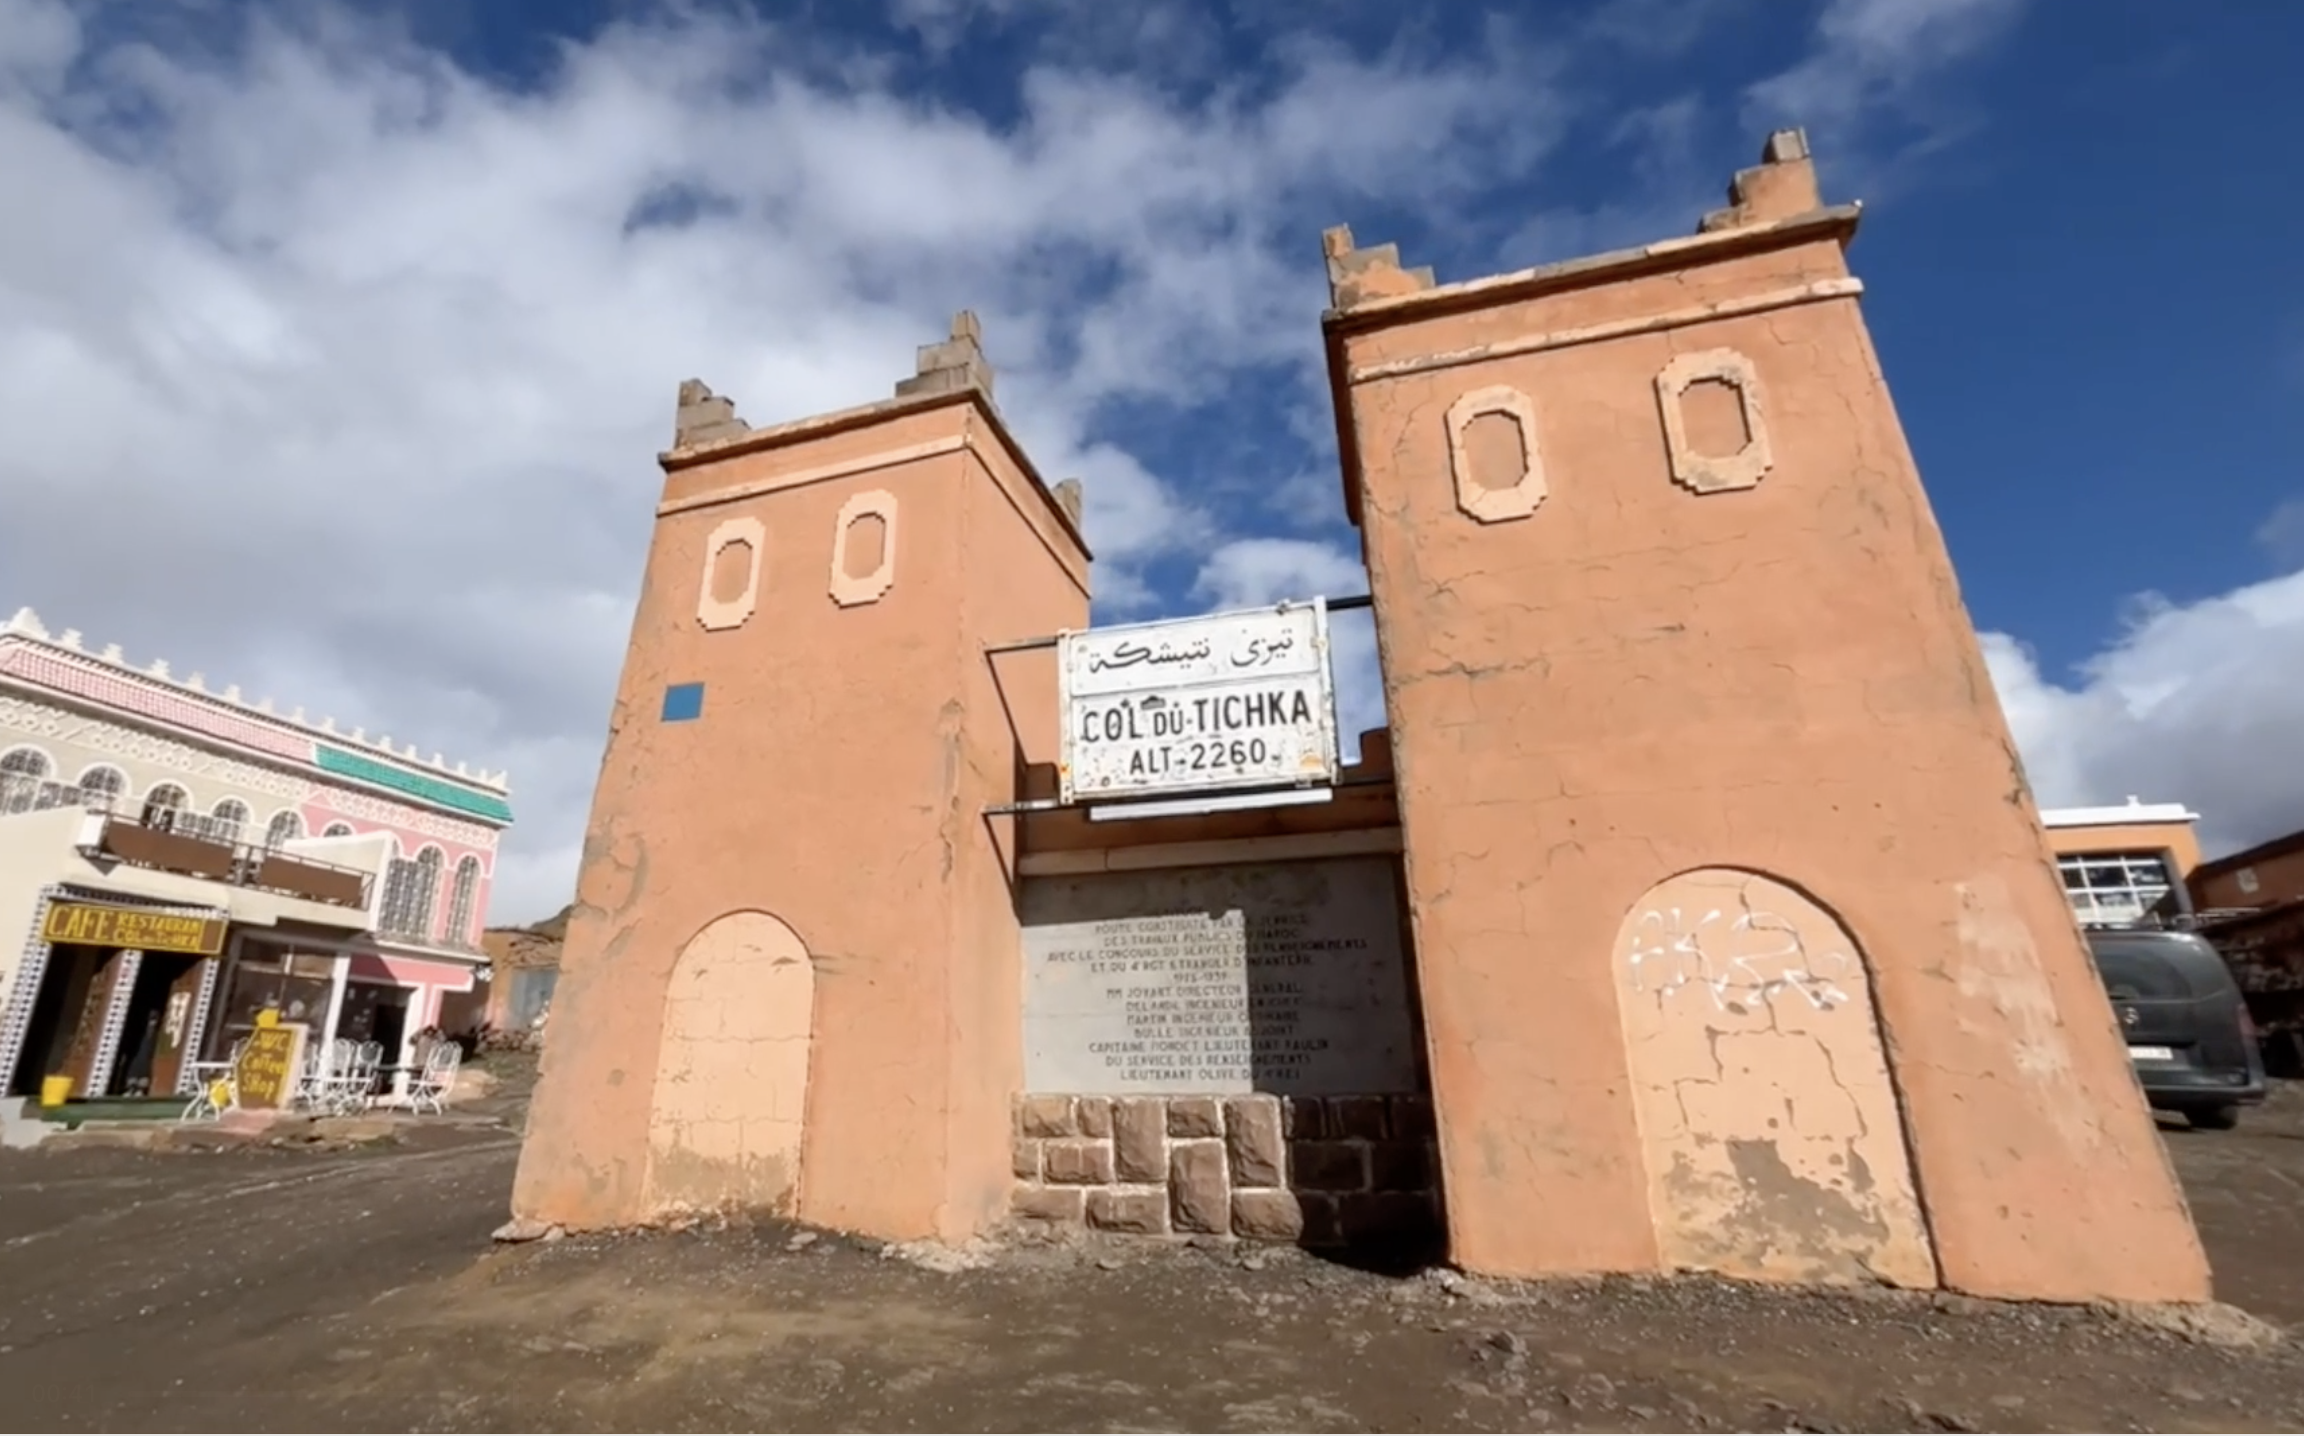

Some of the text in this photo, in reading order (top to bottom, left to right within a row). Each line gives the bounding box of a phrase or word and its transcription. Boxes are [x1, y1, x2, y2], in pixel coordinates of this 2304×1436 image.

[1083, 689, 1311, 743] COL DU TICHKA
[1104, 936, 1127, 947] DES
[1079, 949, 1094, 961] LE
[1163, 945, 1179, 957] DU
[1091, 963, 1105, 973] ET
[1110, 962, 1126, 973] DU
[1106, 1055, 1122, 1067] DU
